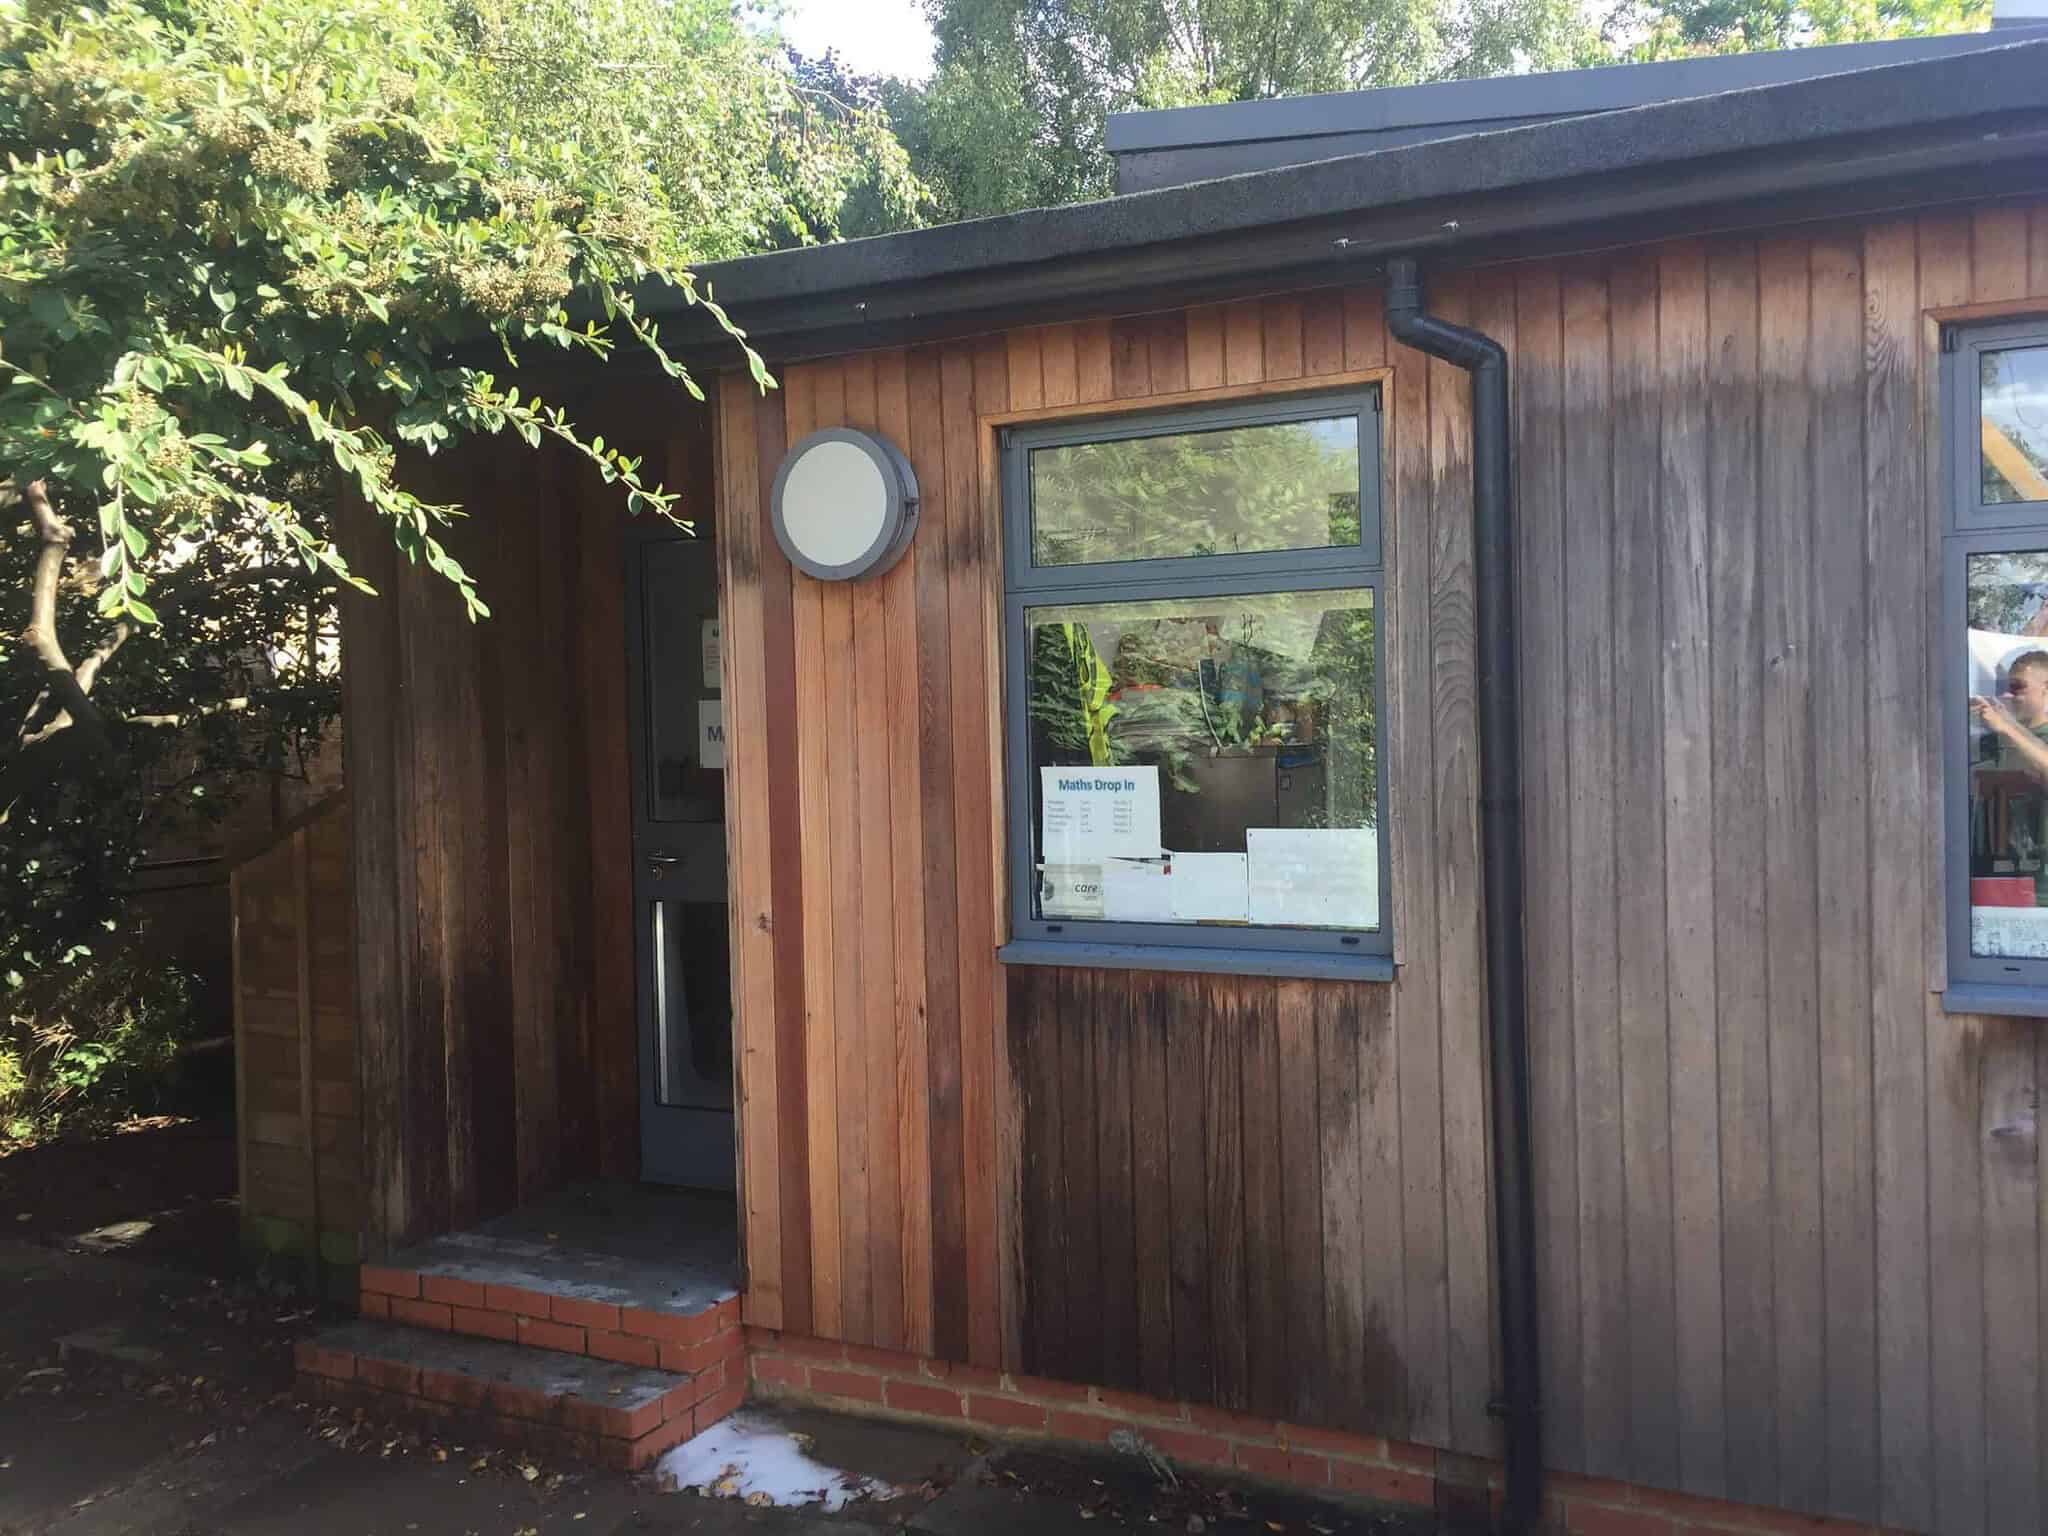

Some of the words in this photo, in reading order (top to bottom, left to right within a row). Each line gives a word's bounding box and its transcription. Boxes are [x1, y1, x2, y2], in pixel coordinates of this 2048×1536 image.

[1058, 778, 1092, 791] Maths
[1094, 778, 1121, 793] Drop
[1124, 777, 1135, 791] In
